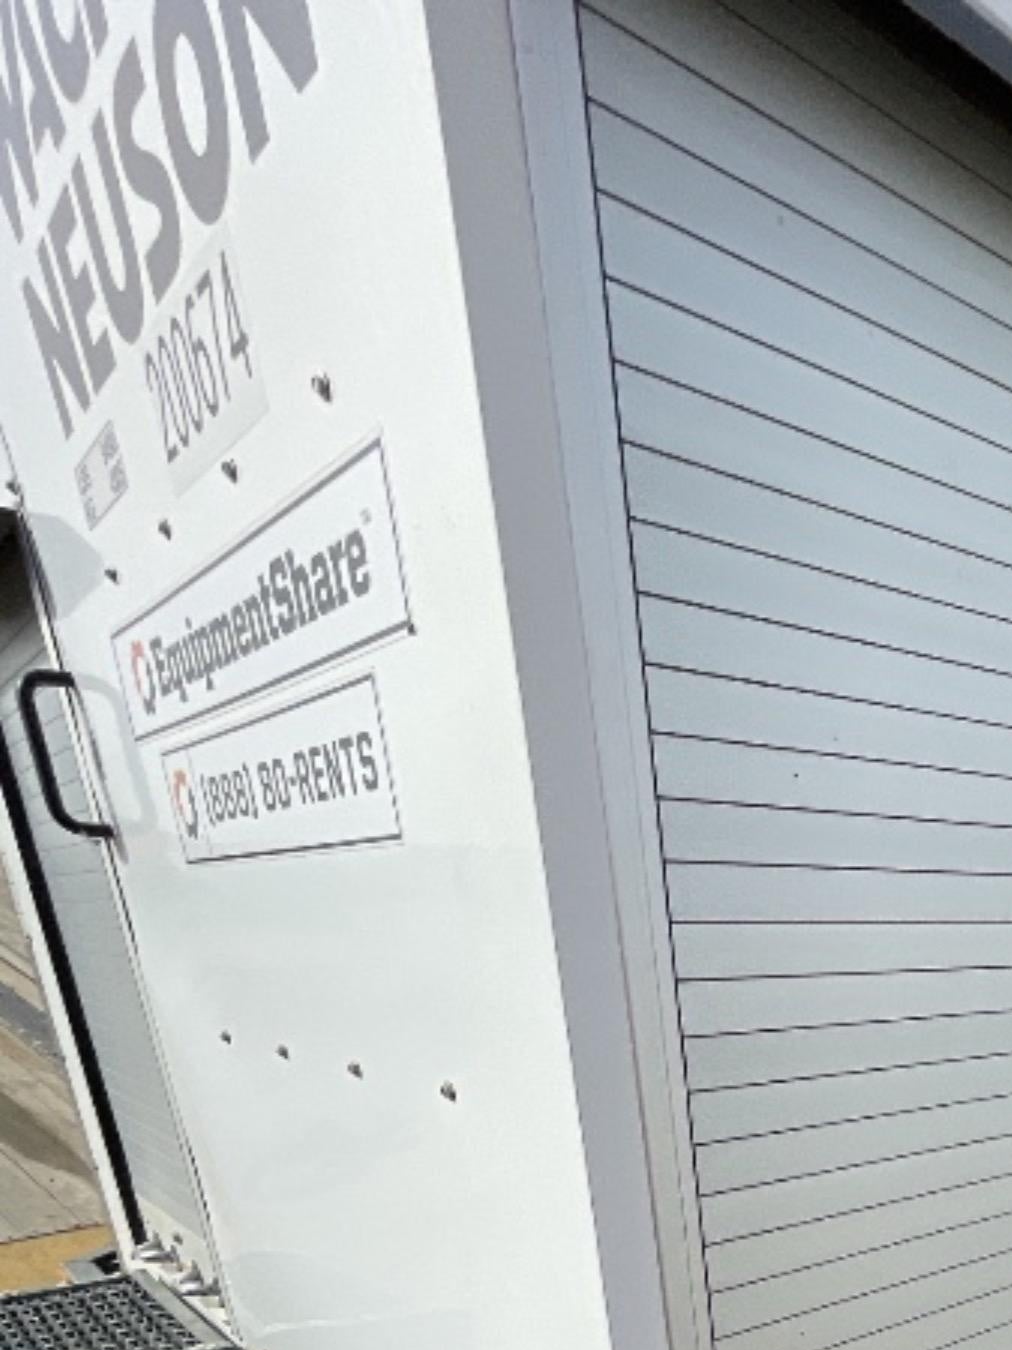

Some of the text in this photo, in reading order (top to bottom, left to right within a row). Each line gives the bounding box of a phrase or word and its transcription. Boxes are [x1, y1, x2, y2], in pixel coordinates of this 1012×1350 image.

[22, 0, 319, 440] NEUSON
[145, 249, 252, 464] 200674
[149, 529, 371, 703] EquipmentShare
[200, 731, 379, 827] (888) 80-RENTS
